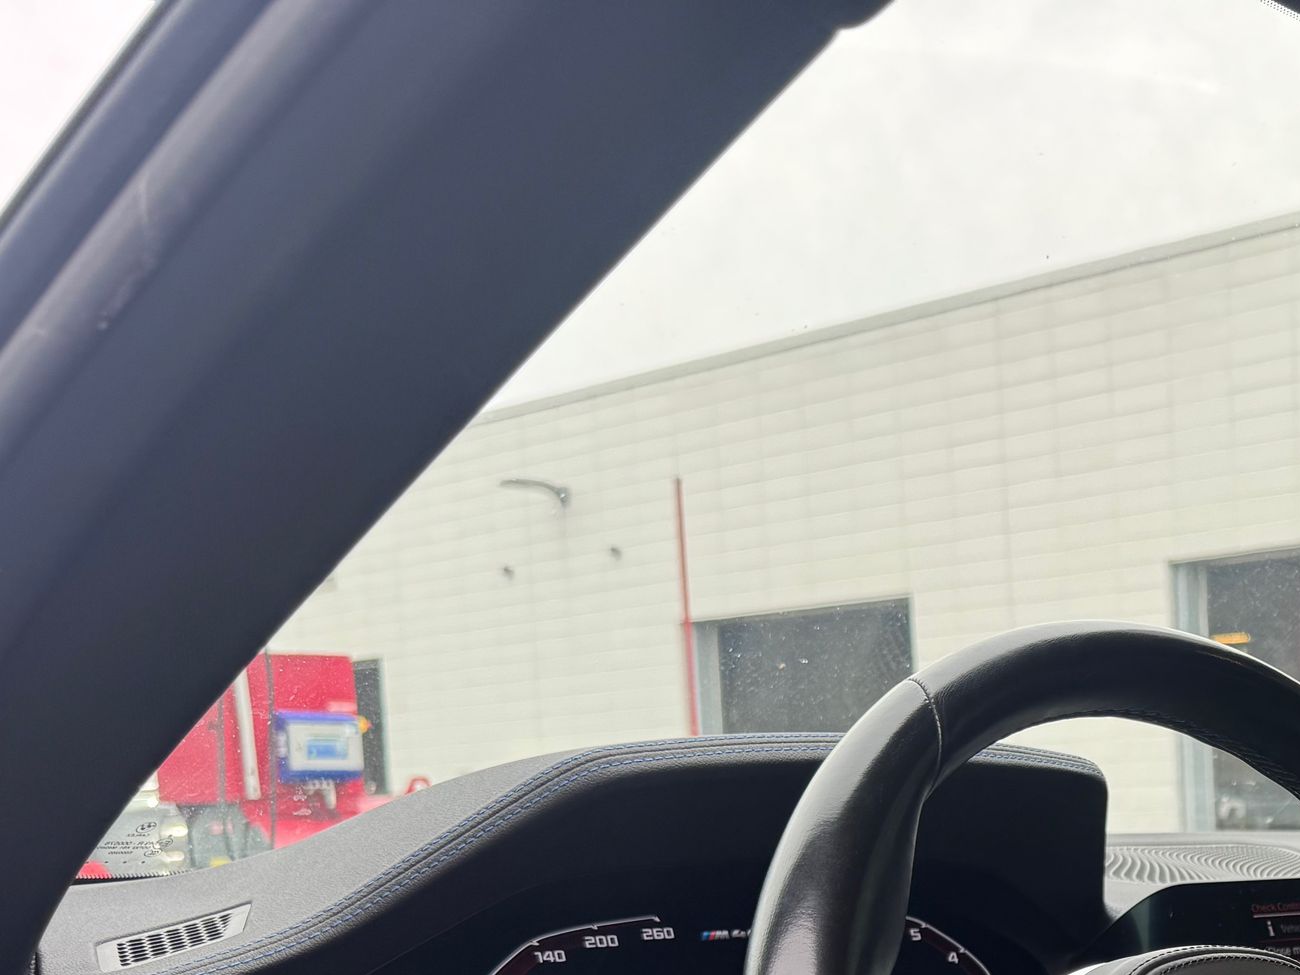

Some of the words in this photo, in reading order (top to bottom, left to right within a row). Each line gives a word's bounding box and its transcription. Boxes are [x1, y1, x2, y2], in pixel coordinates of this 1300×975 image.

[641, 928, 675, 940] 260
[910, 928, 922, 941] 5
[584, 934, 619, 948] 200
[534, 950, 567, 964] 140
[948, 952, 960, 965] 4
